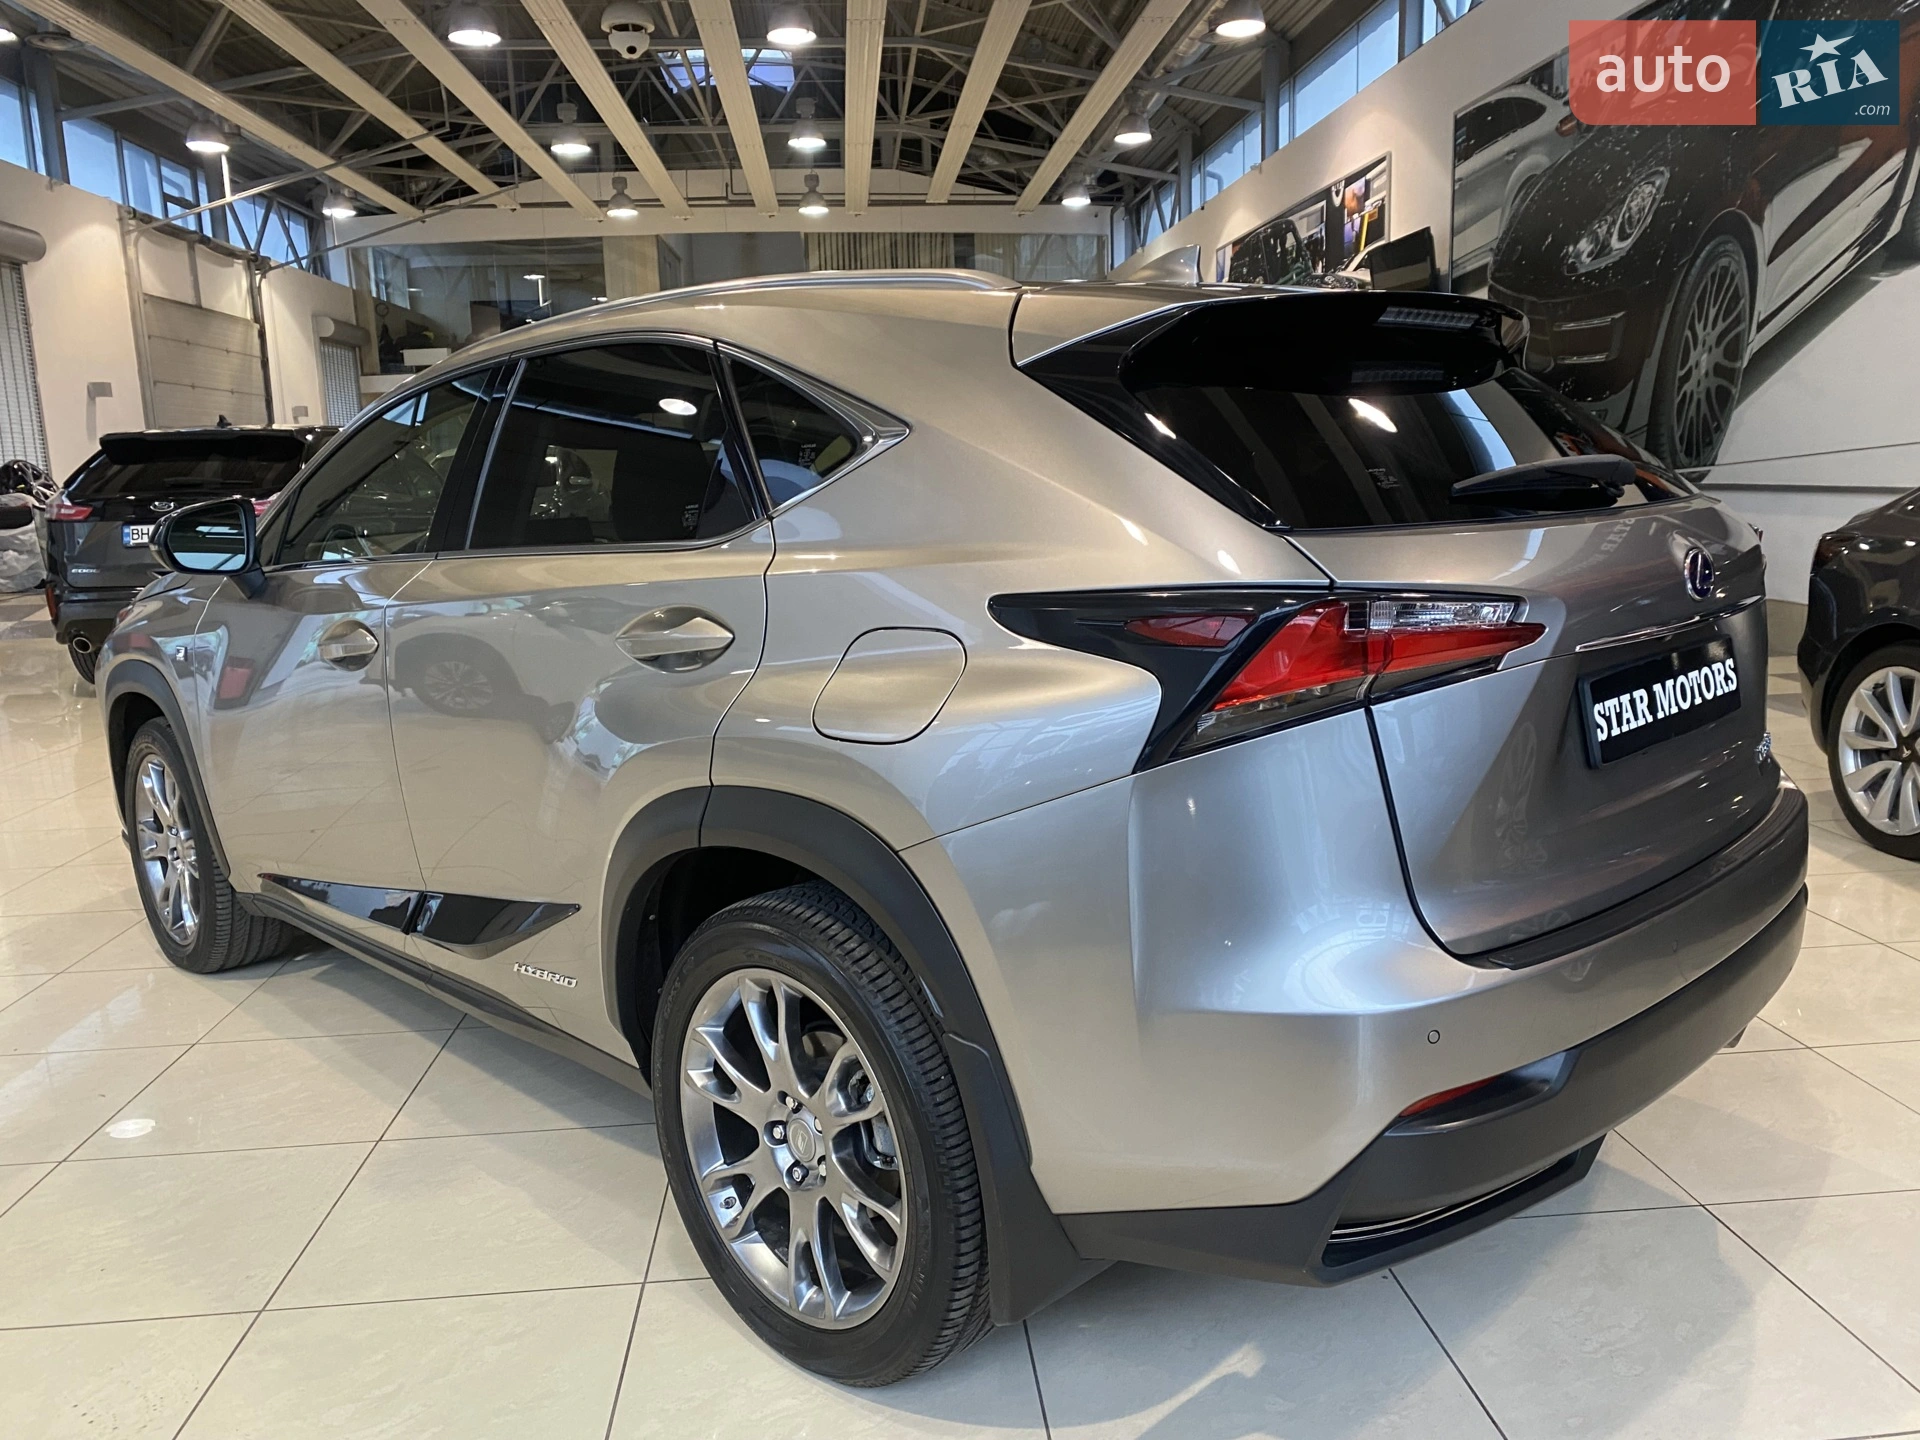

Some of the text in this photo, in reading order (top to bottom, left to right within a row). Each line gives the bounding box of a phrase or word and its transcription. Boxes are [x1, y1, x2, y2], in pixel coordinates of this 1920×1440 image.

[131, 527, 150, 541] BH
[1593, 657, 1738, 742] STAR MOTORS
[513, 962, 578, 989] HYBRID
